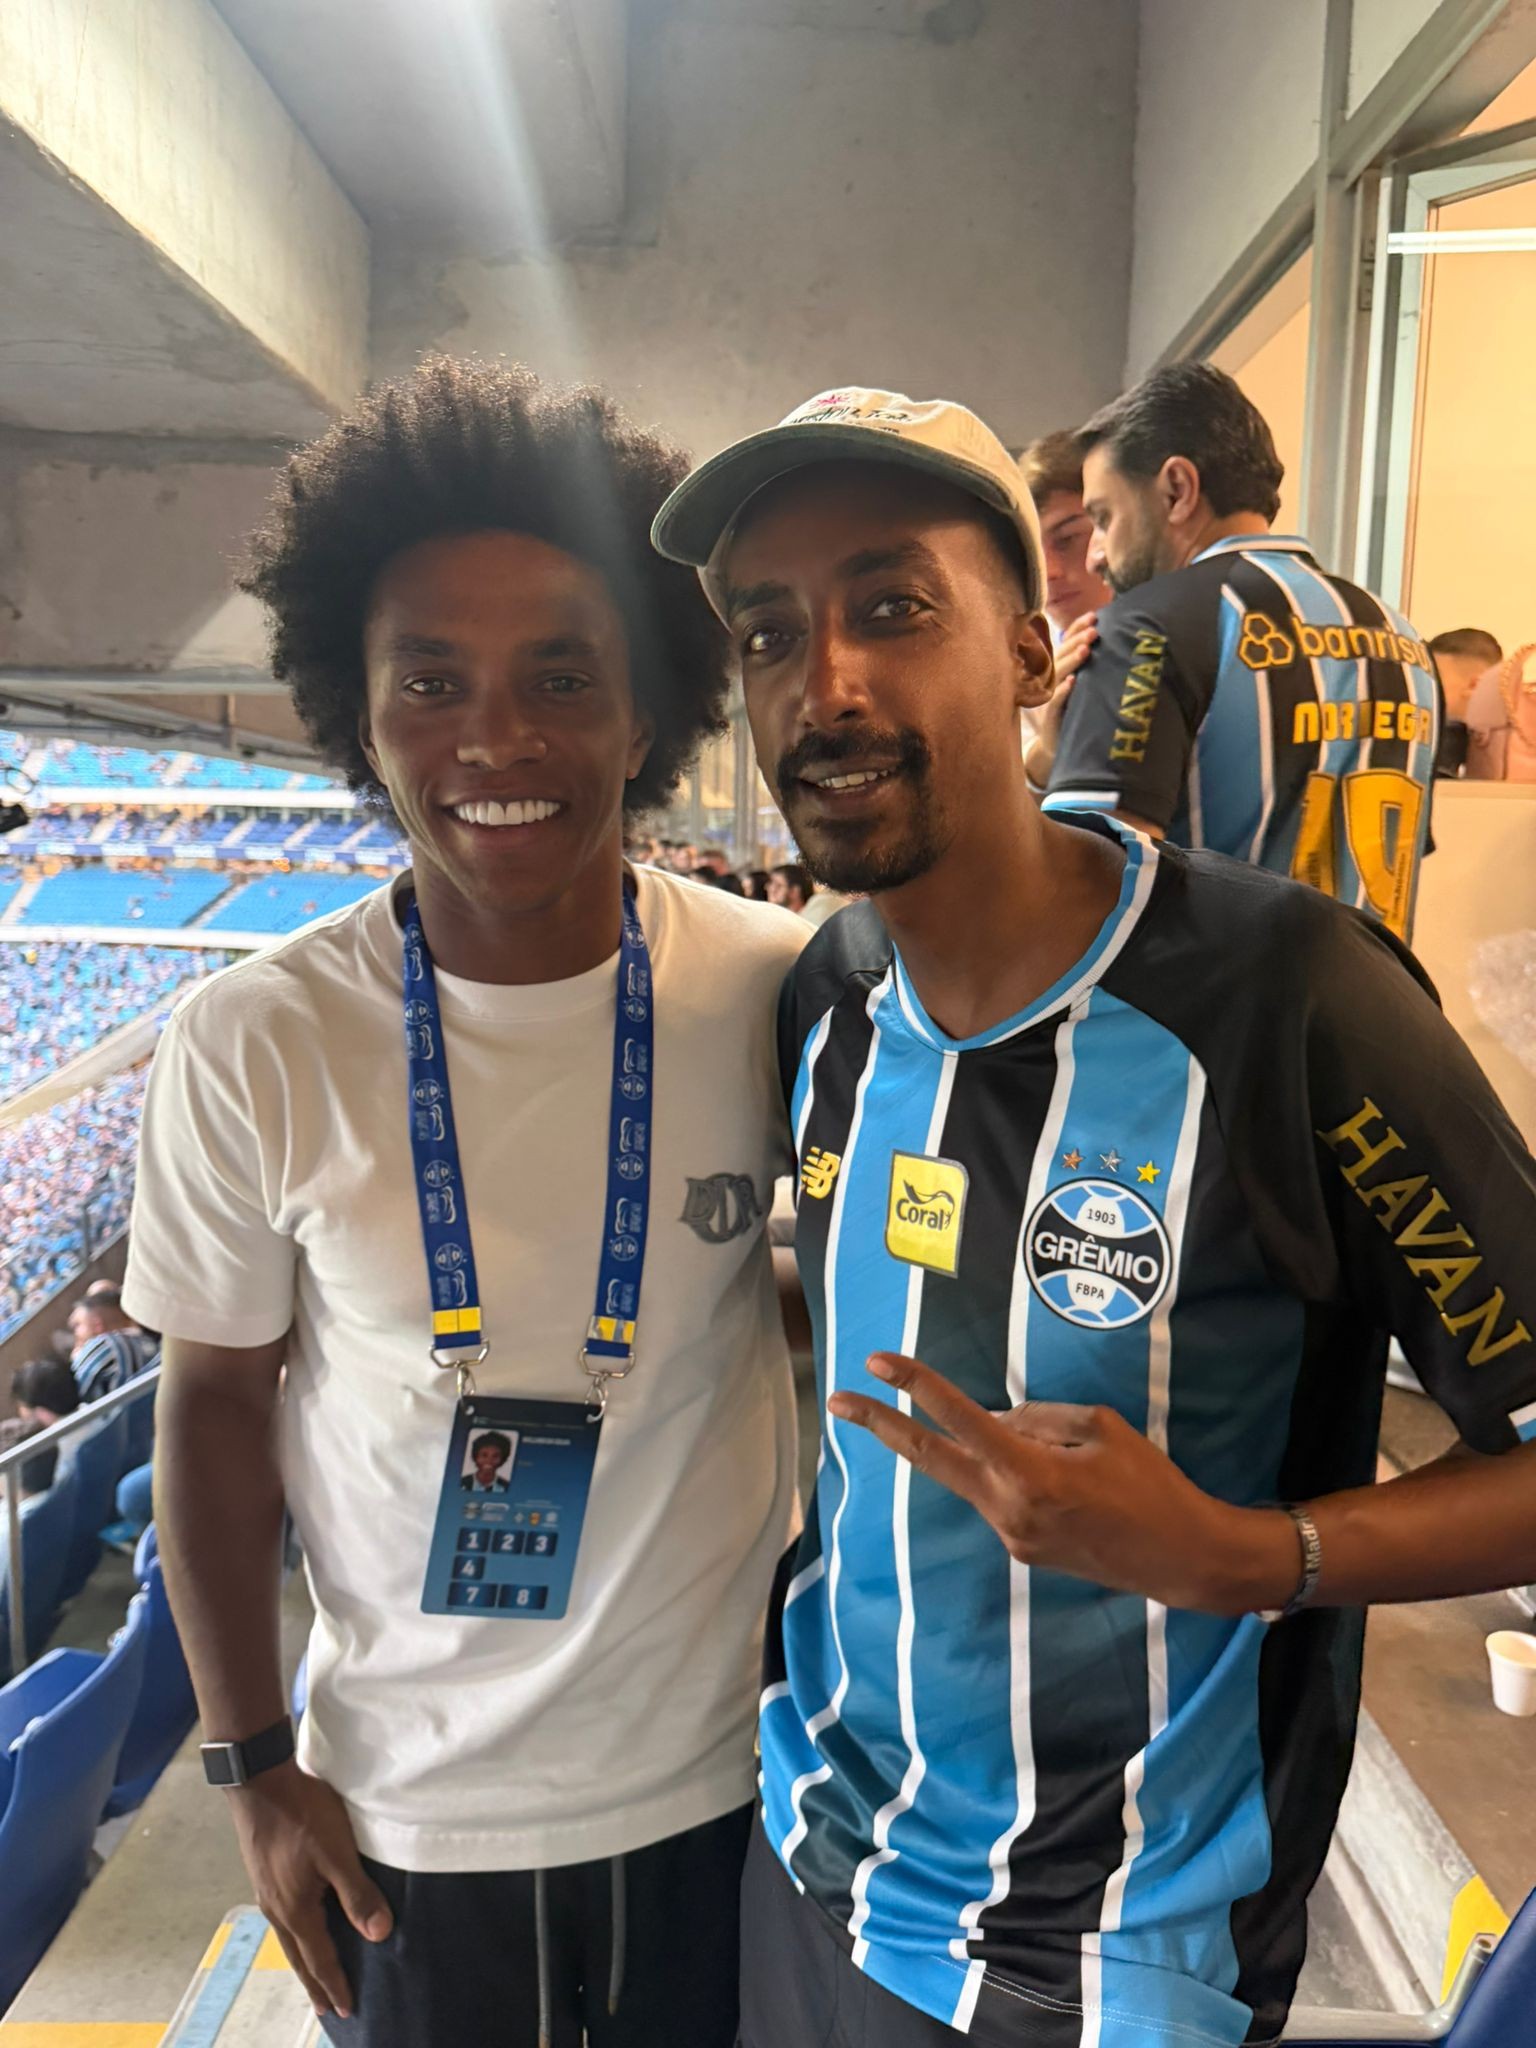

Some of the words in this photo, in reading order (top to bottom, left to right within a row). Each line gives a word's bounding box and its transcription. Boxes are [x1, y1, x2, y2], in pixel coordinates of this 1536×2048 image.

[1292, 615, 1433, 674] banrisu
[1109, 629, 1168, 763] HAVAN
[896, 1198, 944, 1232] Coral
[1086, 1207, 1117, 1226] 1903
[1315, 1096, 1533, 1367] HAVAN
[1034, 1234, 1160, 1285] GRÊMIO
[1074, 1282, 1106, 1300] FBPA
[467, 1532, 480, 1550] 1
[501, 1533, 516, 1551] 2
[535, 1535, 549, 1552] 3
[461, 1560, 476, 1577] 4
[466, 1586, 480, 1604] 7
[516, 1589, 530, 1606] 8
